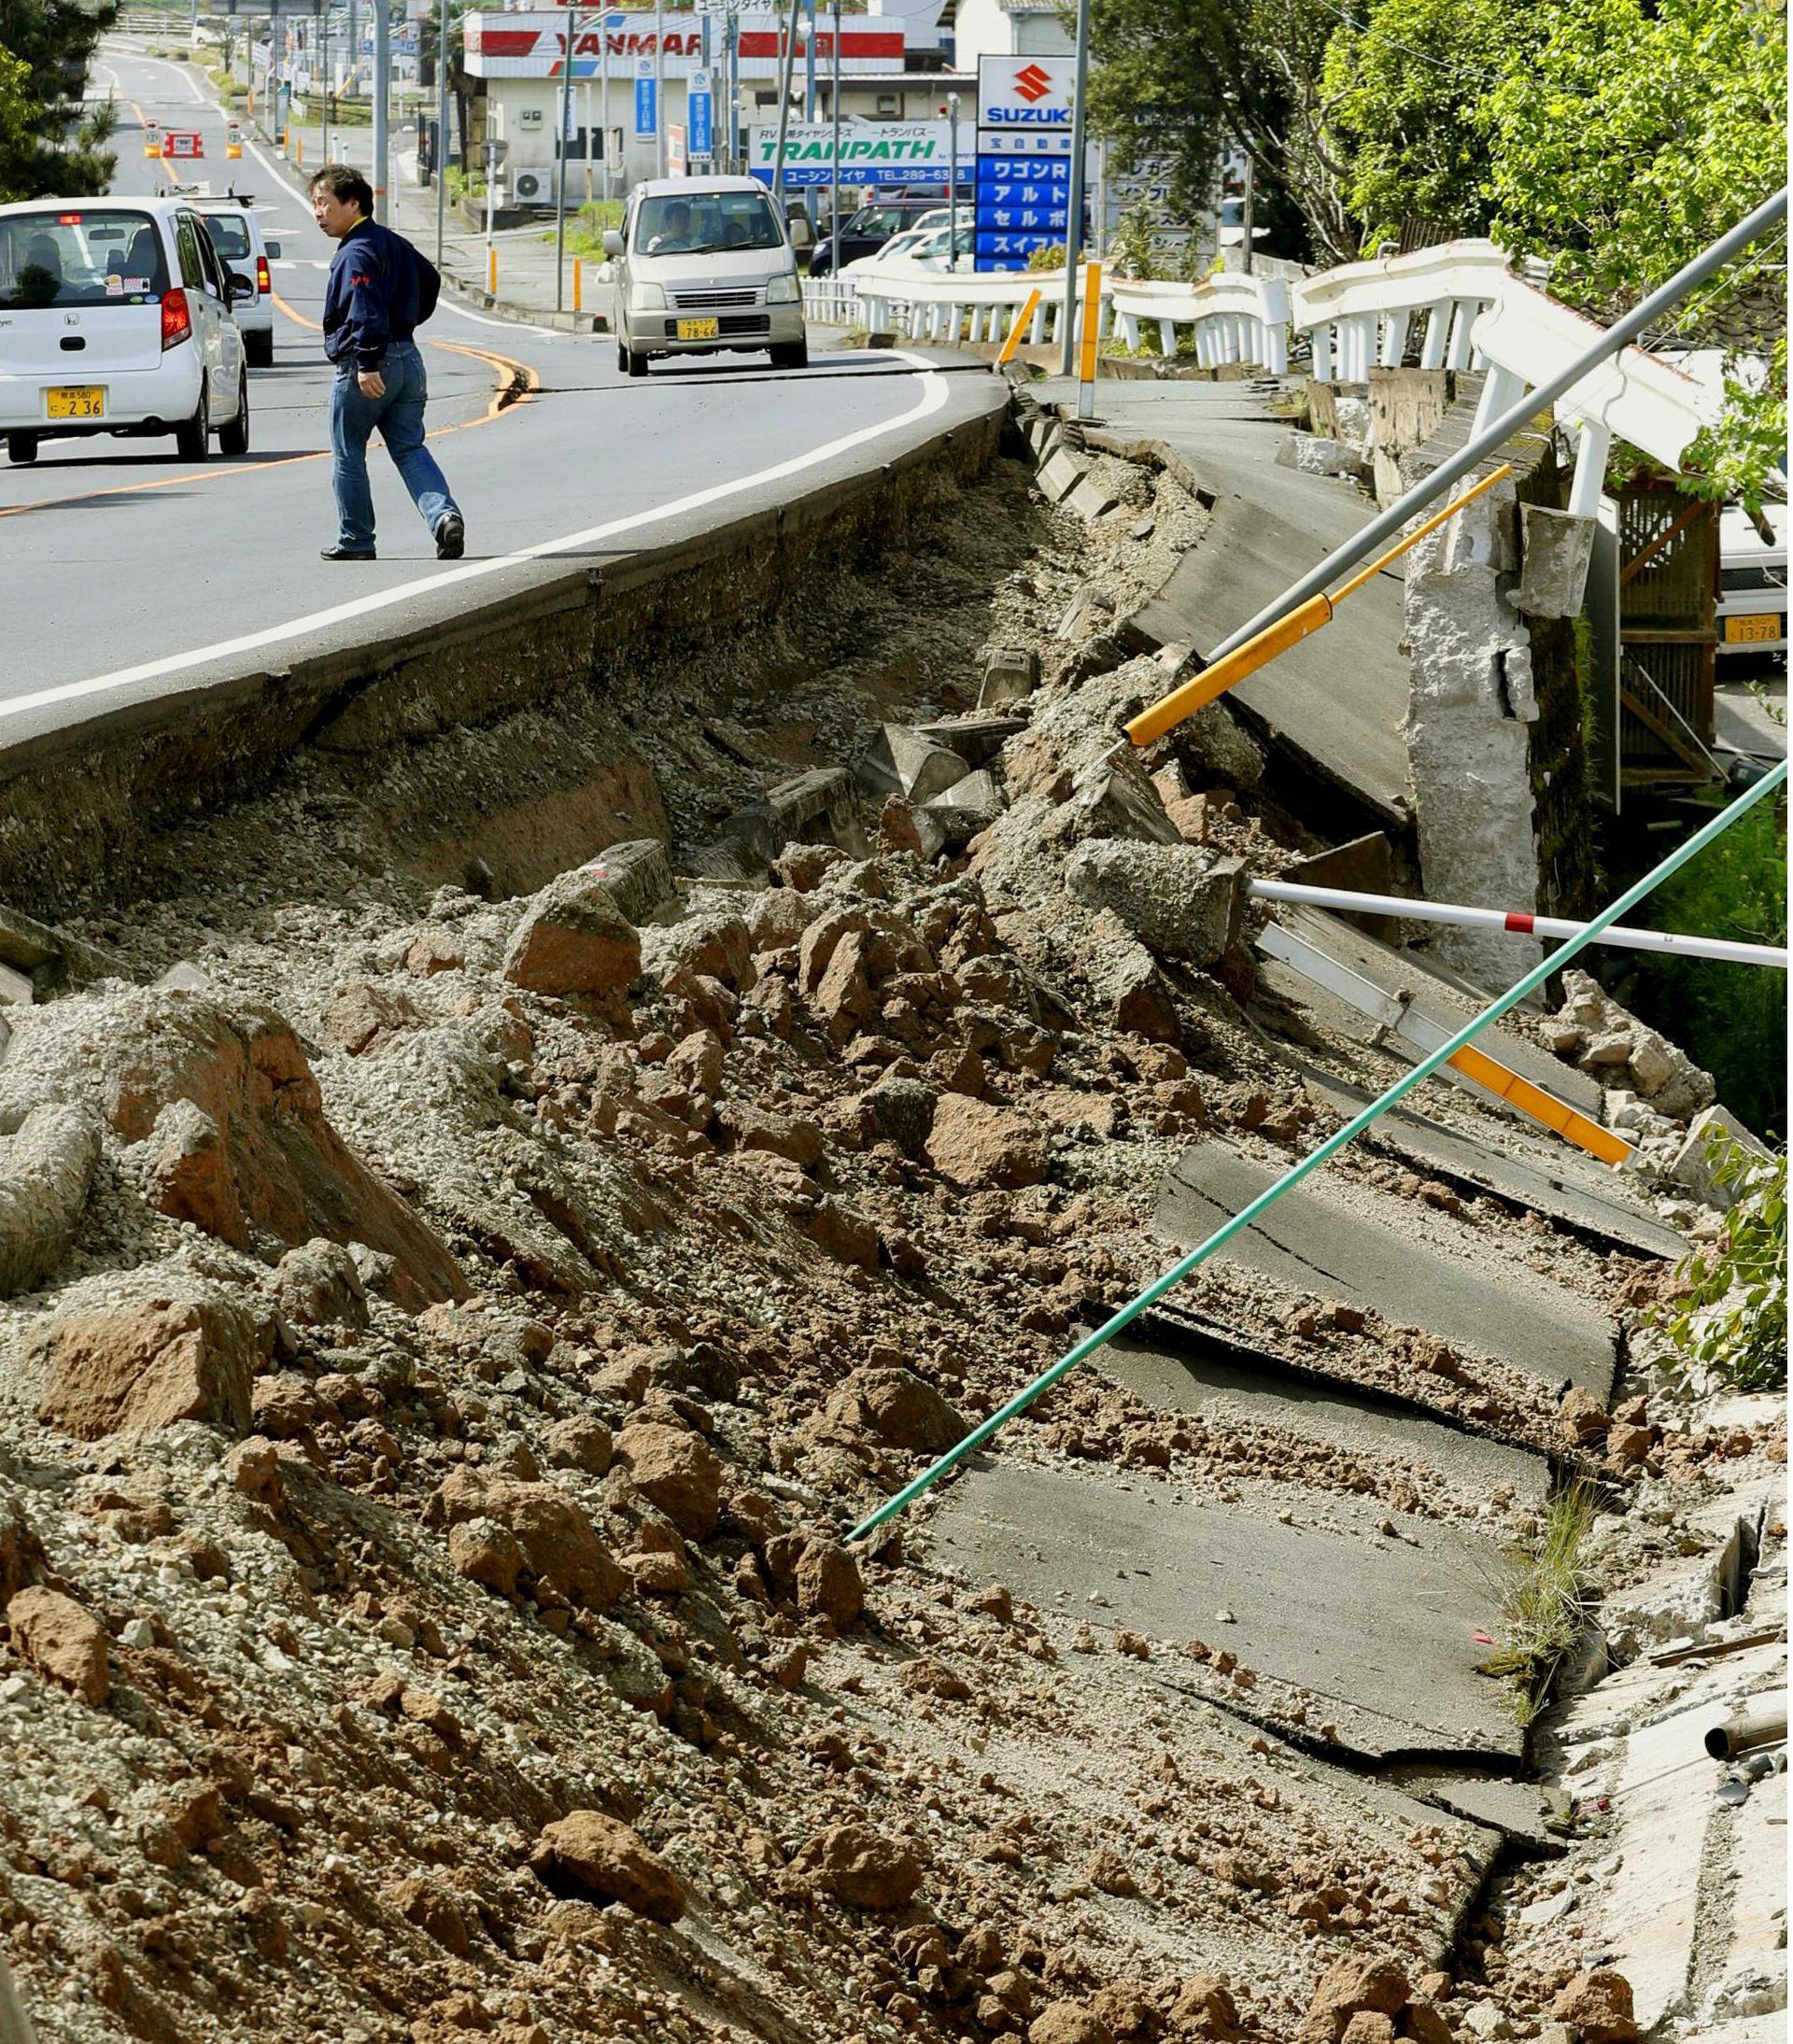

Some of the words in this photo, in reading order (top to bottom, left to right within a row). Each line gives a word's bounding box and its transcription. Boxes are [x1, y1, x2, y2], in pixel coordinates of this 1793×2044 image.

[556, 33, 702, 56] YANMAR
[987, 107, 1072, 122] SUZUK
[760, 140, 936, 161] TRANPATH
[994, 162, 1066, 179] ワゴンR
[994, 185, 1066, 204] アルト
[1739, 626, 1776, 641] 13-78
